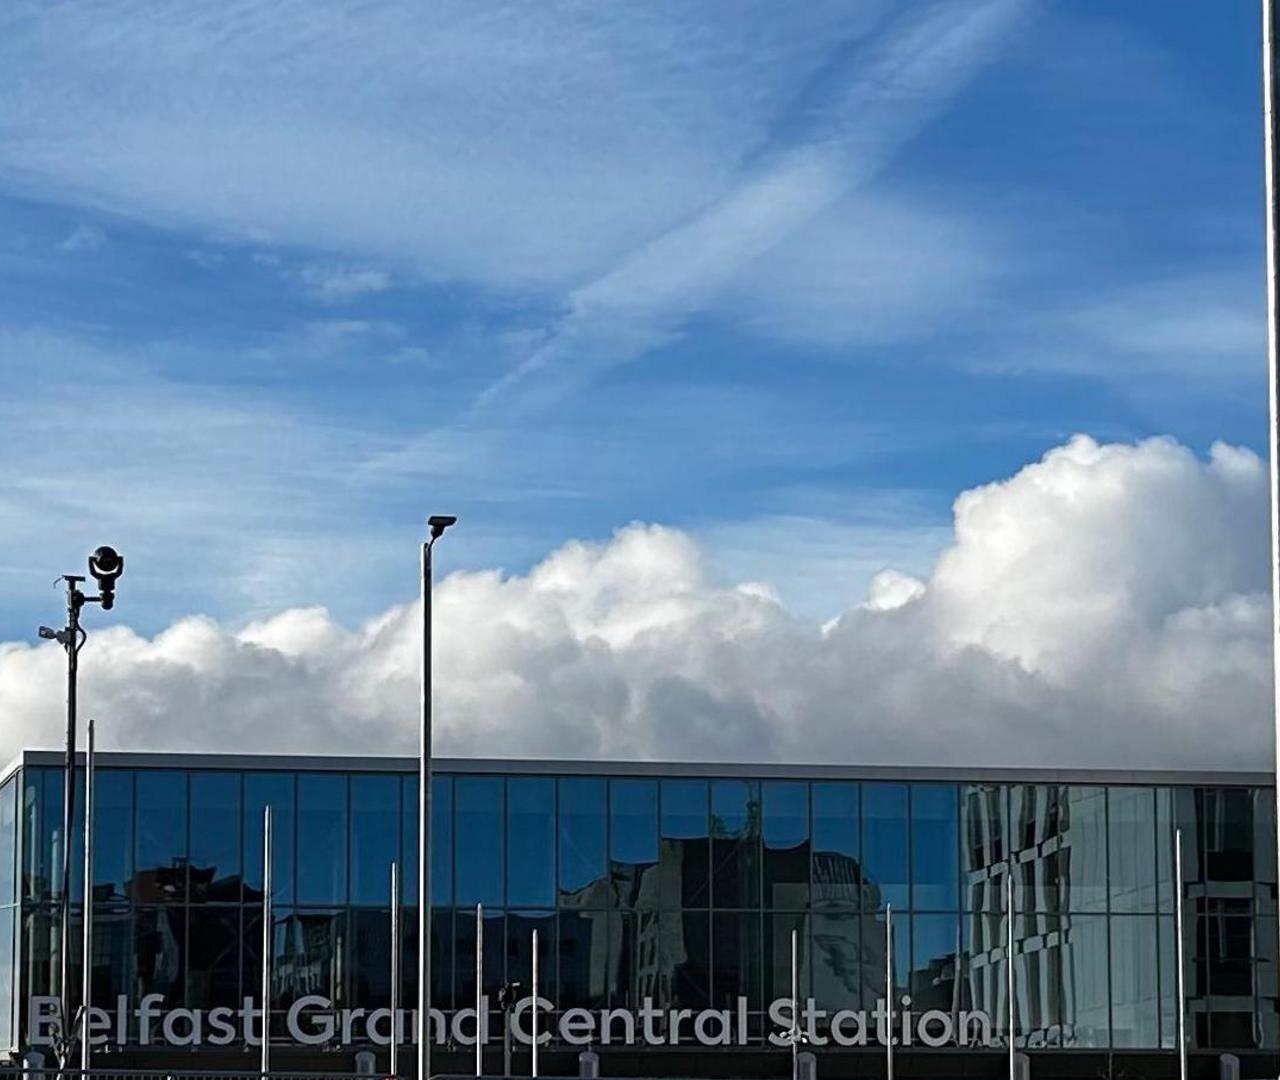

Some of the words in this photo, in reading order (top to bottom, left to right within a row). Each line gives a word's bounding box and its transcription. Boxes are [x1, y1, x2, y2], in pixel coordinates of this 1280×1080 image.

[30, 994, 264, 1046] Belfast
[286, 995, 490, 1045] Grand
[510, 996, 749, 1046] Central
[768, 995, 992, 1047] Station
